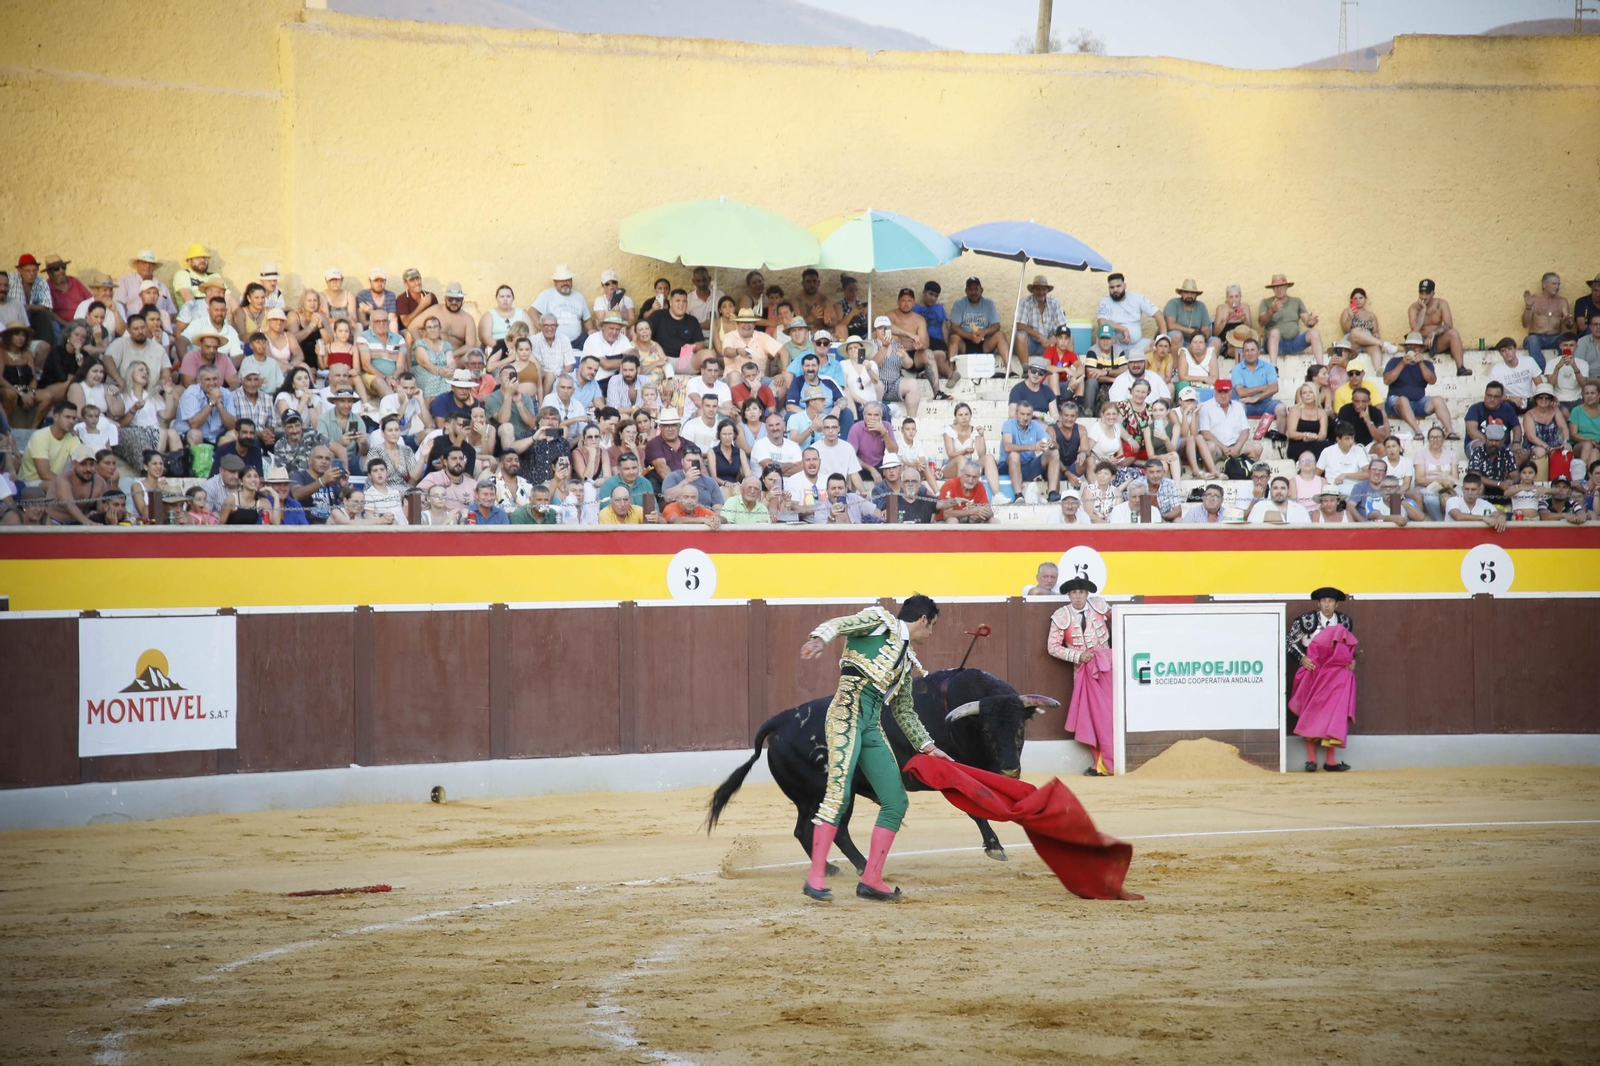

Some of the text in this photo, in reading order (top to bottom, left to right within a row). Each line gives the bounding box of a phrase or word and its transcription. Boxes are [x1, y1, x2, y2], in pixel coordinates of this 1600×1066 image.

[684, 566, 700, 590] 5
[1480, 561, 1496, 583] 5
[1154, 660, 1264, 676] CAMPOEJIDO
[87, 695, 207, 725] MONTIVEL
